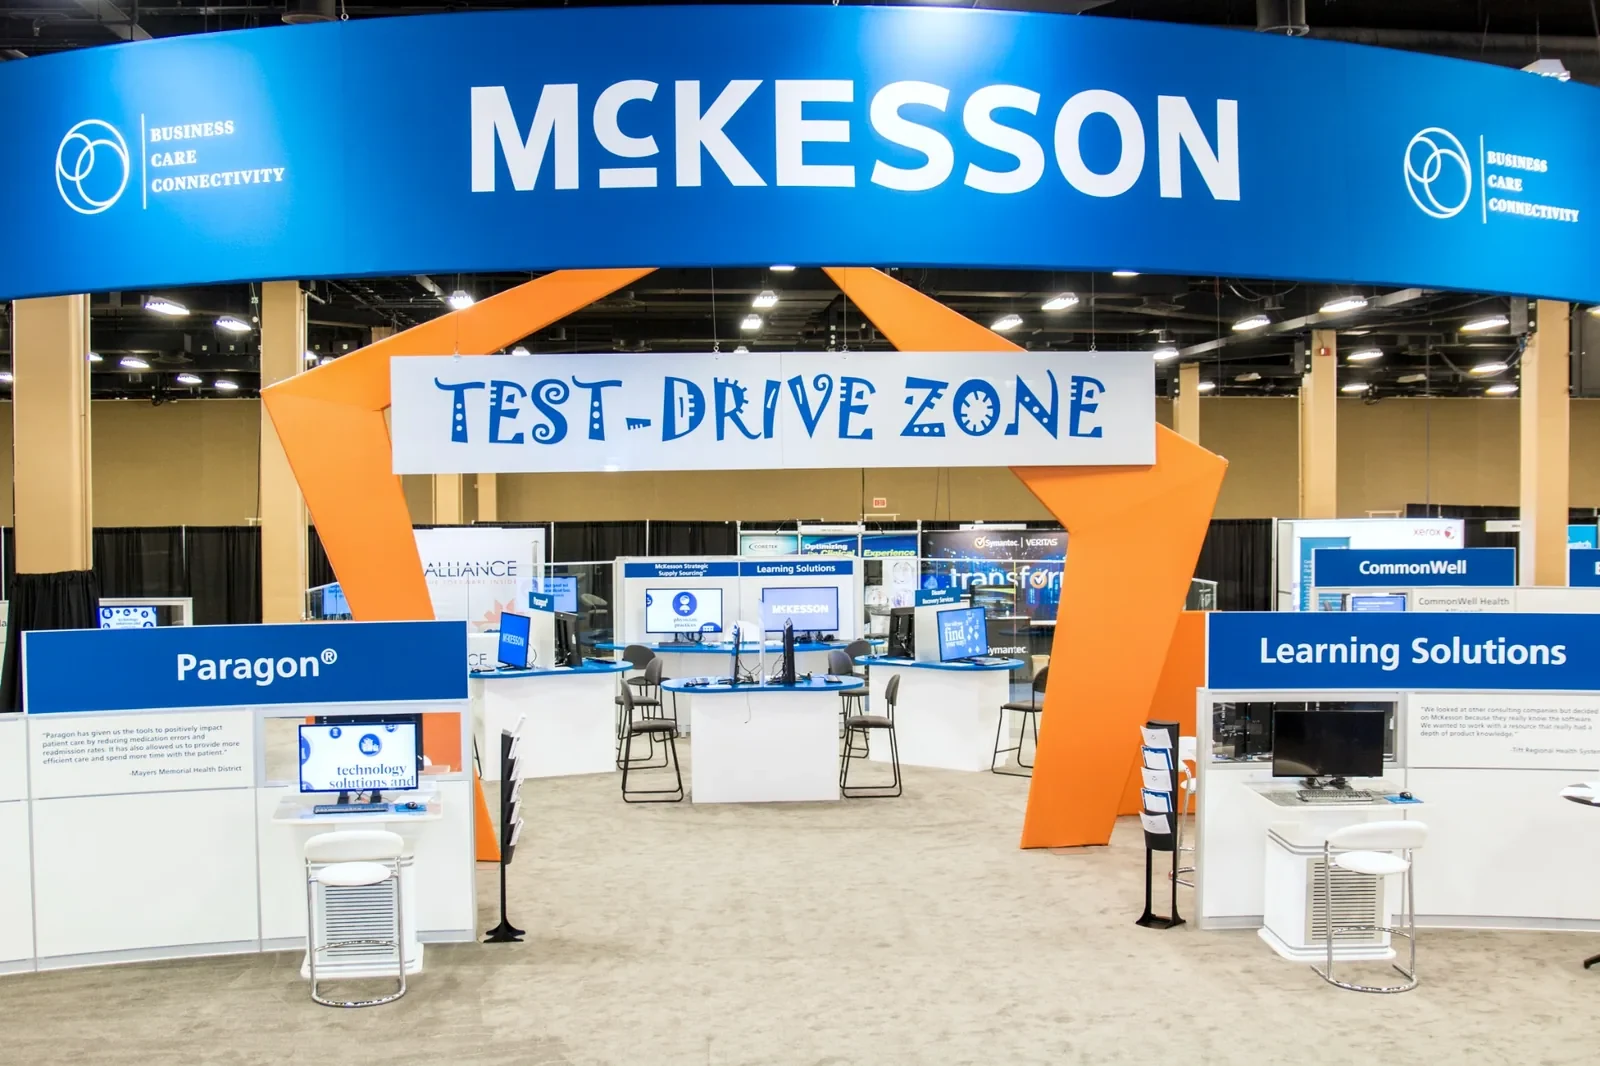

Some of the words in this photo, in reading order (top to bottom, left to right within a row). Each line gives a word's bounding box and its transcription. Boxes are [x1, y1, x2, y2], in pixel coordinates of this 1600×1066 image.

[149, 120, 235, 142] BUSINESS
[150, 149, 197, 167] CARE
[1486, 150, 1548, 173] BUSINESS
[151, 167, 285, 193] CONNECTIVITY
[1487, 174, 1523, 192] CARE
[1488, 197, 1580, 223] CONNECTIVITY
[434, 373, 876, 445] TEST-DRIVE
[900, 369, 1106, 440] ZONE
[1413, 528, 1441, 536] xerox
[1025, 538, 1058, 546] VERITAS
[424, 561, 517, 577] ALLIANCE
[757, 566, 794, 574] Learning
[796, 565, 836, 573] Solutions
[1359, 560, 1467, 575] CommonWell
[1418, 597, 1478, 605] CommonWell
[1480, 597, 1510, 605] Health
[944, 626, 964, 641] find
[1260, 637, 1400, 671] Learning
[1411, 637, 1567, 665] Solutions
[91, 729, 111, 738] given
[164, 725, 198, 733] positively
[199, 724, 223, 732] impact
[42, 740, 69, 748] patient
[129, 735, 169, 743] medication
[42, 748, 86, 756] readmission
[193, 740, 221, 749] provide
[42, 756, 73, 764] efficient
[106, 753, 127, 762] spend
[158, 767, 192, 775] Memorial
[337, 764, 407, 776] technology
[329, 777, 387, 789] solutions
[390, 775, 415, 787] and
